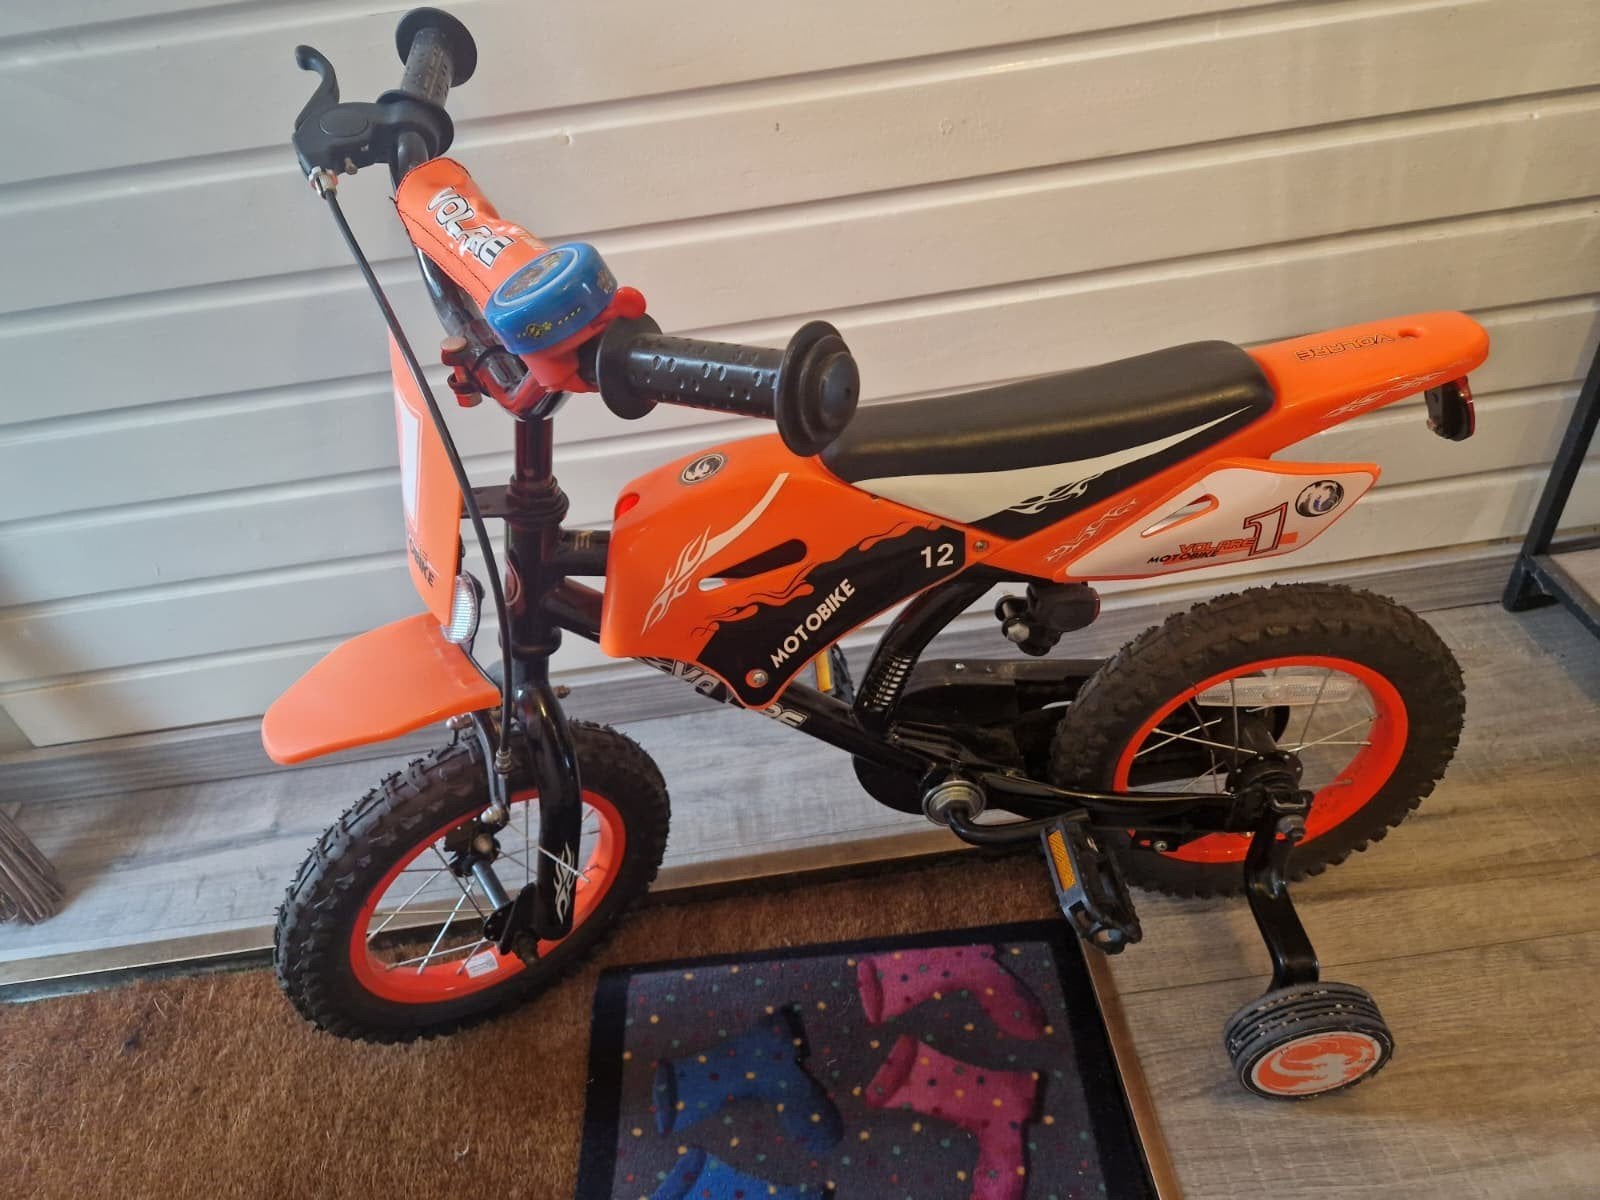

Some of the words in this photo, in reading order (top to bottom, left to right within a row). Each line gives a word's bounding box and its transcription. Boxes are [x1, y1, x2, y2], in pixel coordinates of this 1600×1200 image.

[1243, 502, 1288, 556] 1
[921, 543, 955, 568] 12
[1147, 550, 1218, 564] MOTOBIKE
[769, 578, 856, 669] MOTOBIKE
